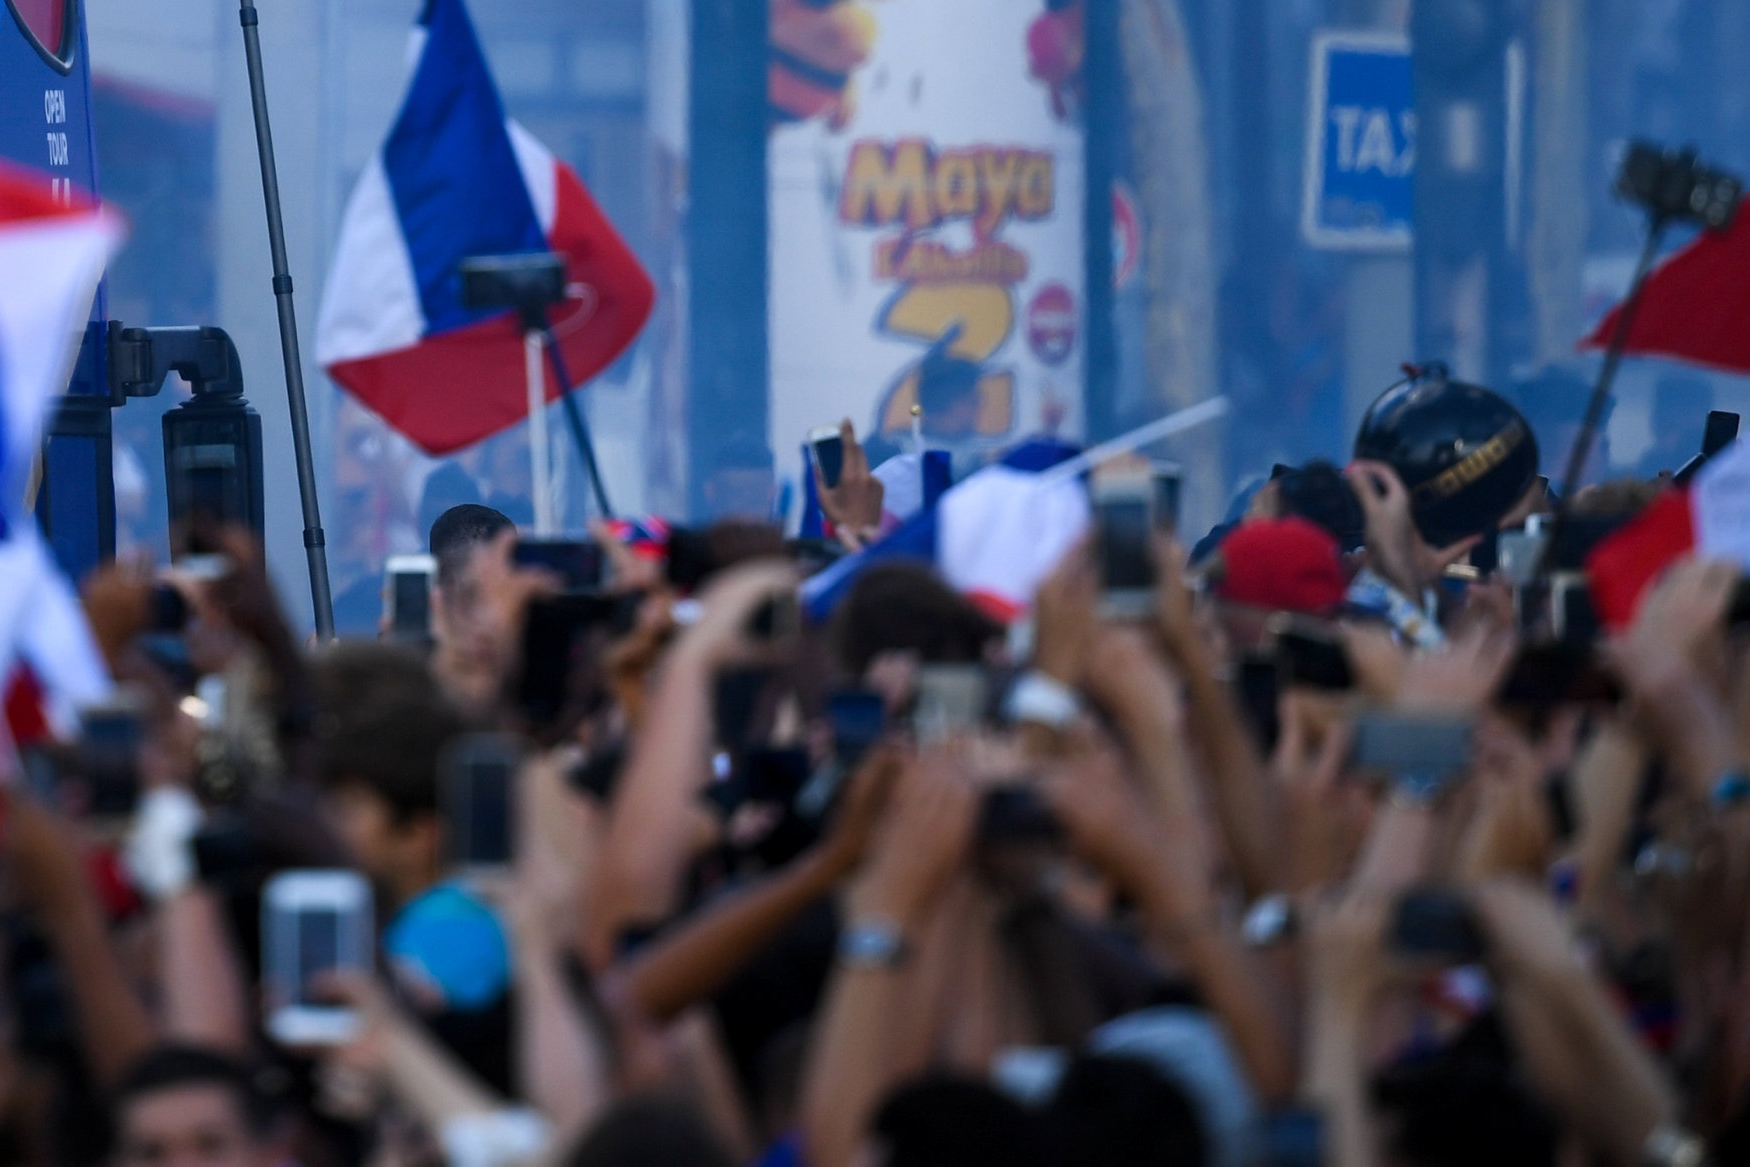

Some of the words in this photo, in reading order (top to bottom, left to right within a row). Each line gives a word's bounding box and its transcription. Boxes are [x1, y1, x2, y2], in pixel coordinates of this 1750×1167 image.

[44, 89, 66, 125] OPEN
[47, 132, 69, 166] TOUR
[838, 136, 1056, 238] Maya
